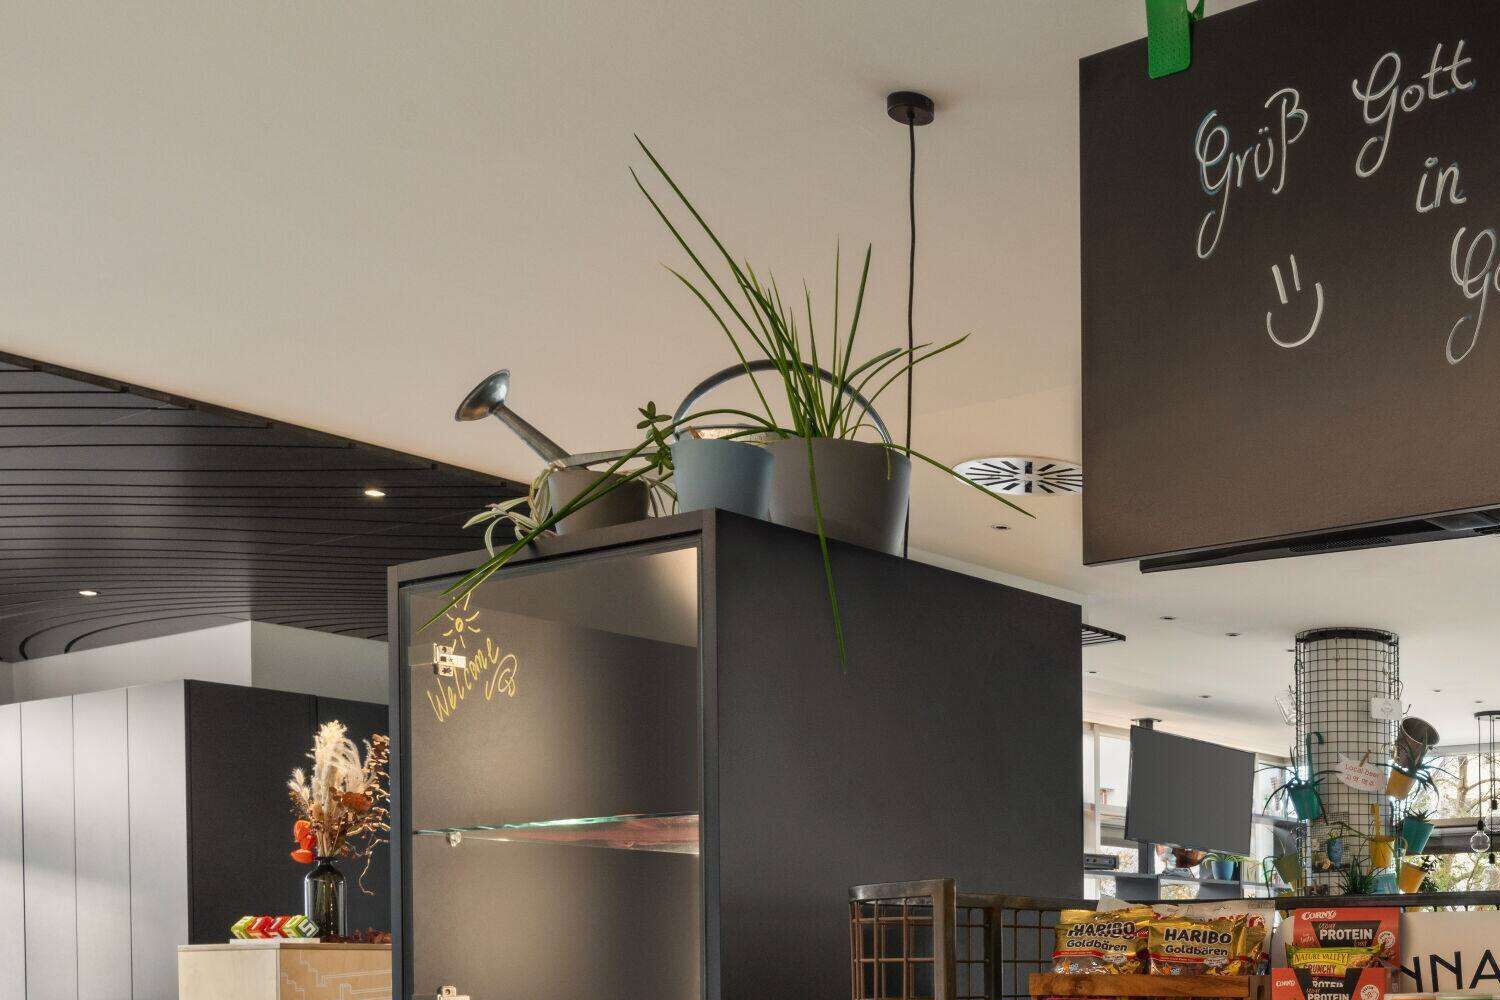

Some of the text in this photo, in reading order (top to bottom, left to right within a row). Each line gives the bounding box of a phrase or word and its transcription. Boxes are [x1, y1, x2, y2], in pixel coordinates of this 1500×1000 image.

[1352, 38, 1477, 179] Gott
[1414, 157, 1468, 213] in
[1067, 921, 1137, 940] HARIBO
[1164, 927, 1232, 945] HARIBO
[1319, 928, 1373, 940] PROTEIN
[1066, 939, 1128, 951] Goldbären
[1165, 944, 1228, 956] Goldbären
